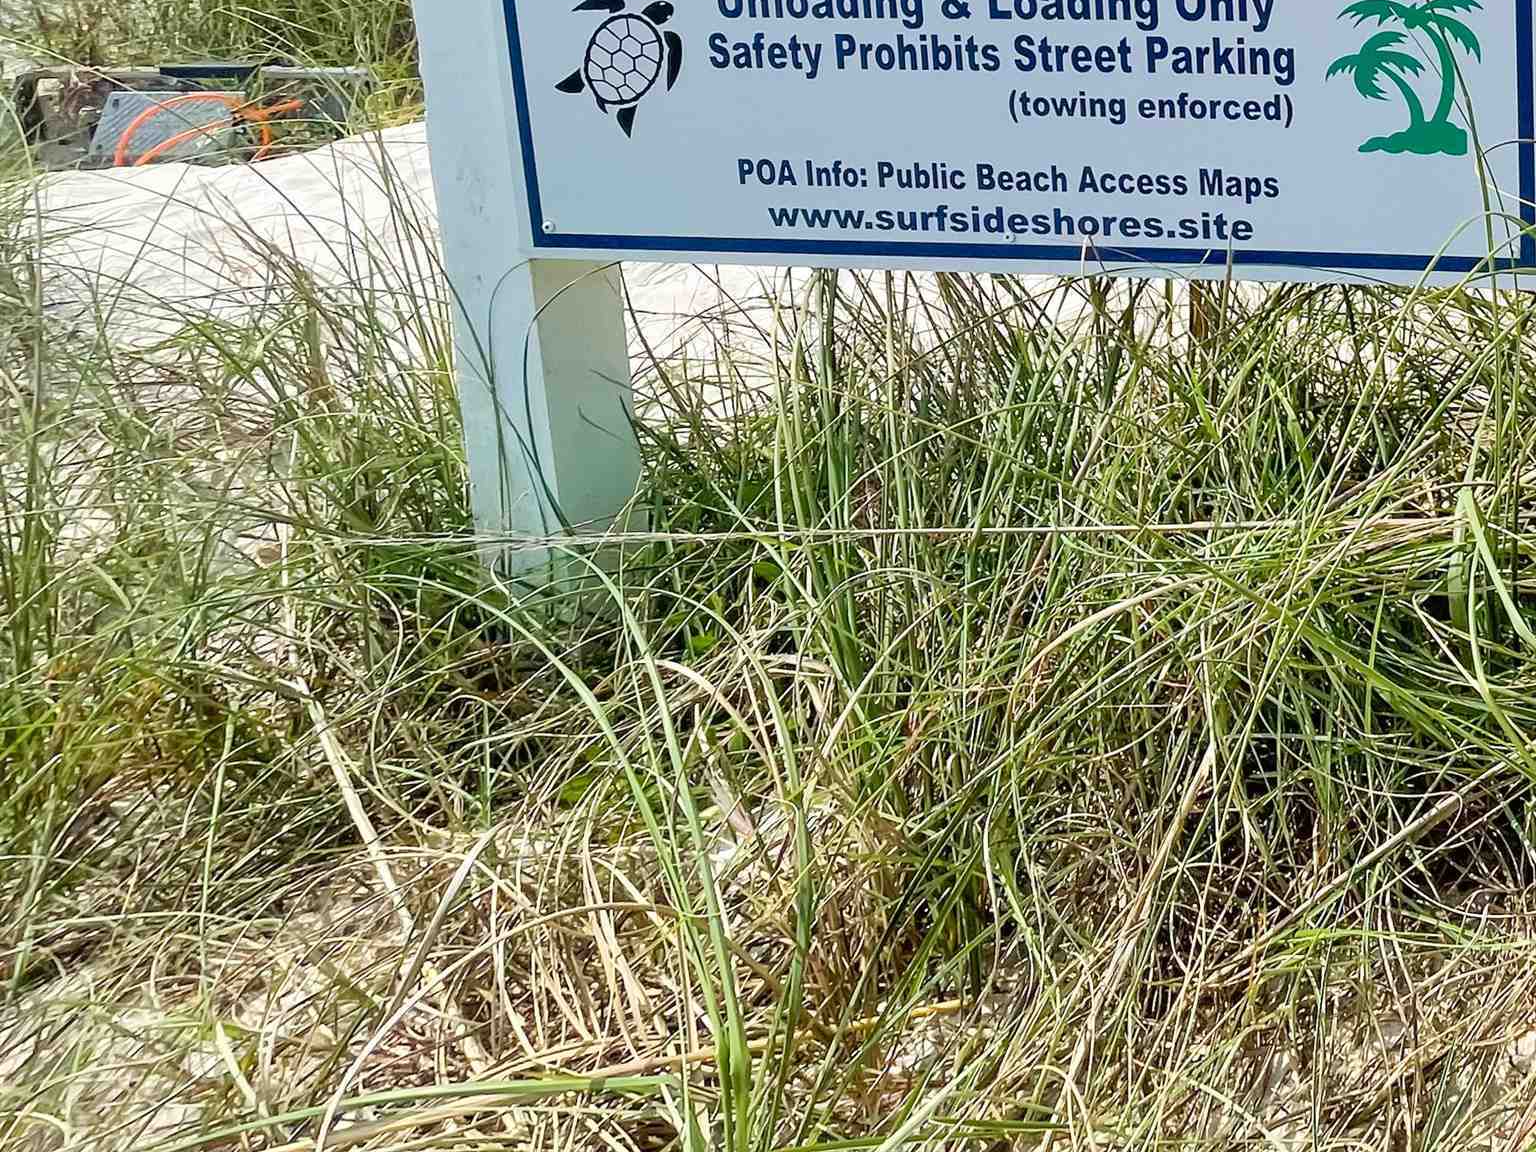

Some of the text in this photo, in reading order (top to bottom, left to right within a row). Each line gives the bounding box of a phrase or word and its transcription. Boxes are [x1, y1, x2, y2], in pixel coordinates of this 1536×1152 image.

[708, 32, 1295, 86] Safety Prohibits Street Parking
[1008, 89, 1293, 129] (towing enforced)
[737, 158, 1280, 204] POA Info: Public Beach Access Maps
[767, 204, 1254, 241] www.surfsideshores.site
